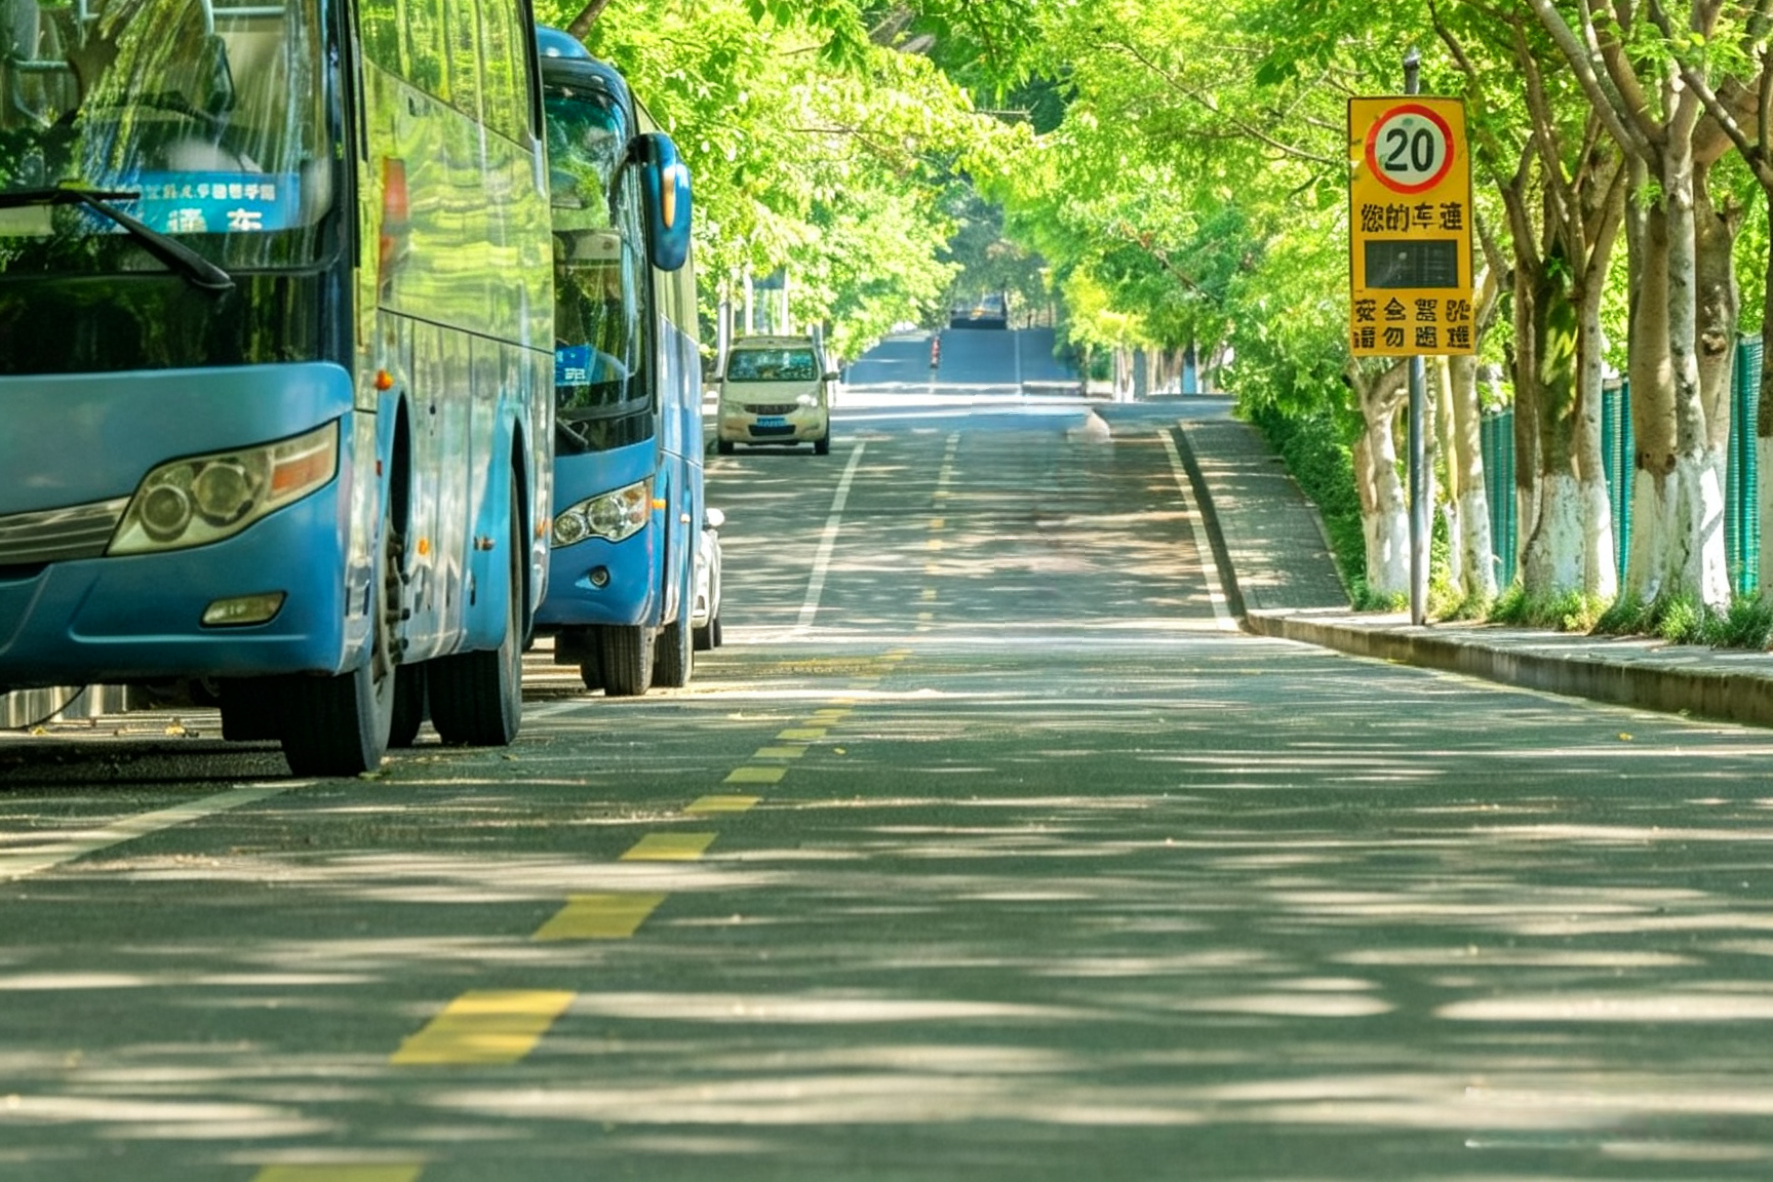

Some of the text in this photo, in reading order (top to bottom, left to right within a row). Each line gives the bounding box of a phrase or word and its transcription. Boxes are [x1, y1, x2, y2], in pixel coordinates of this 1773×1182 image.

[1385, 128, 1434, 172] 20
[1361, 202, 1462, 232] 您的车速
